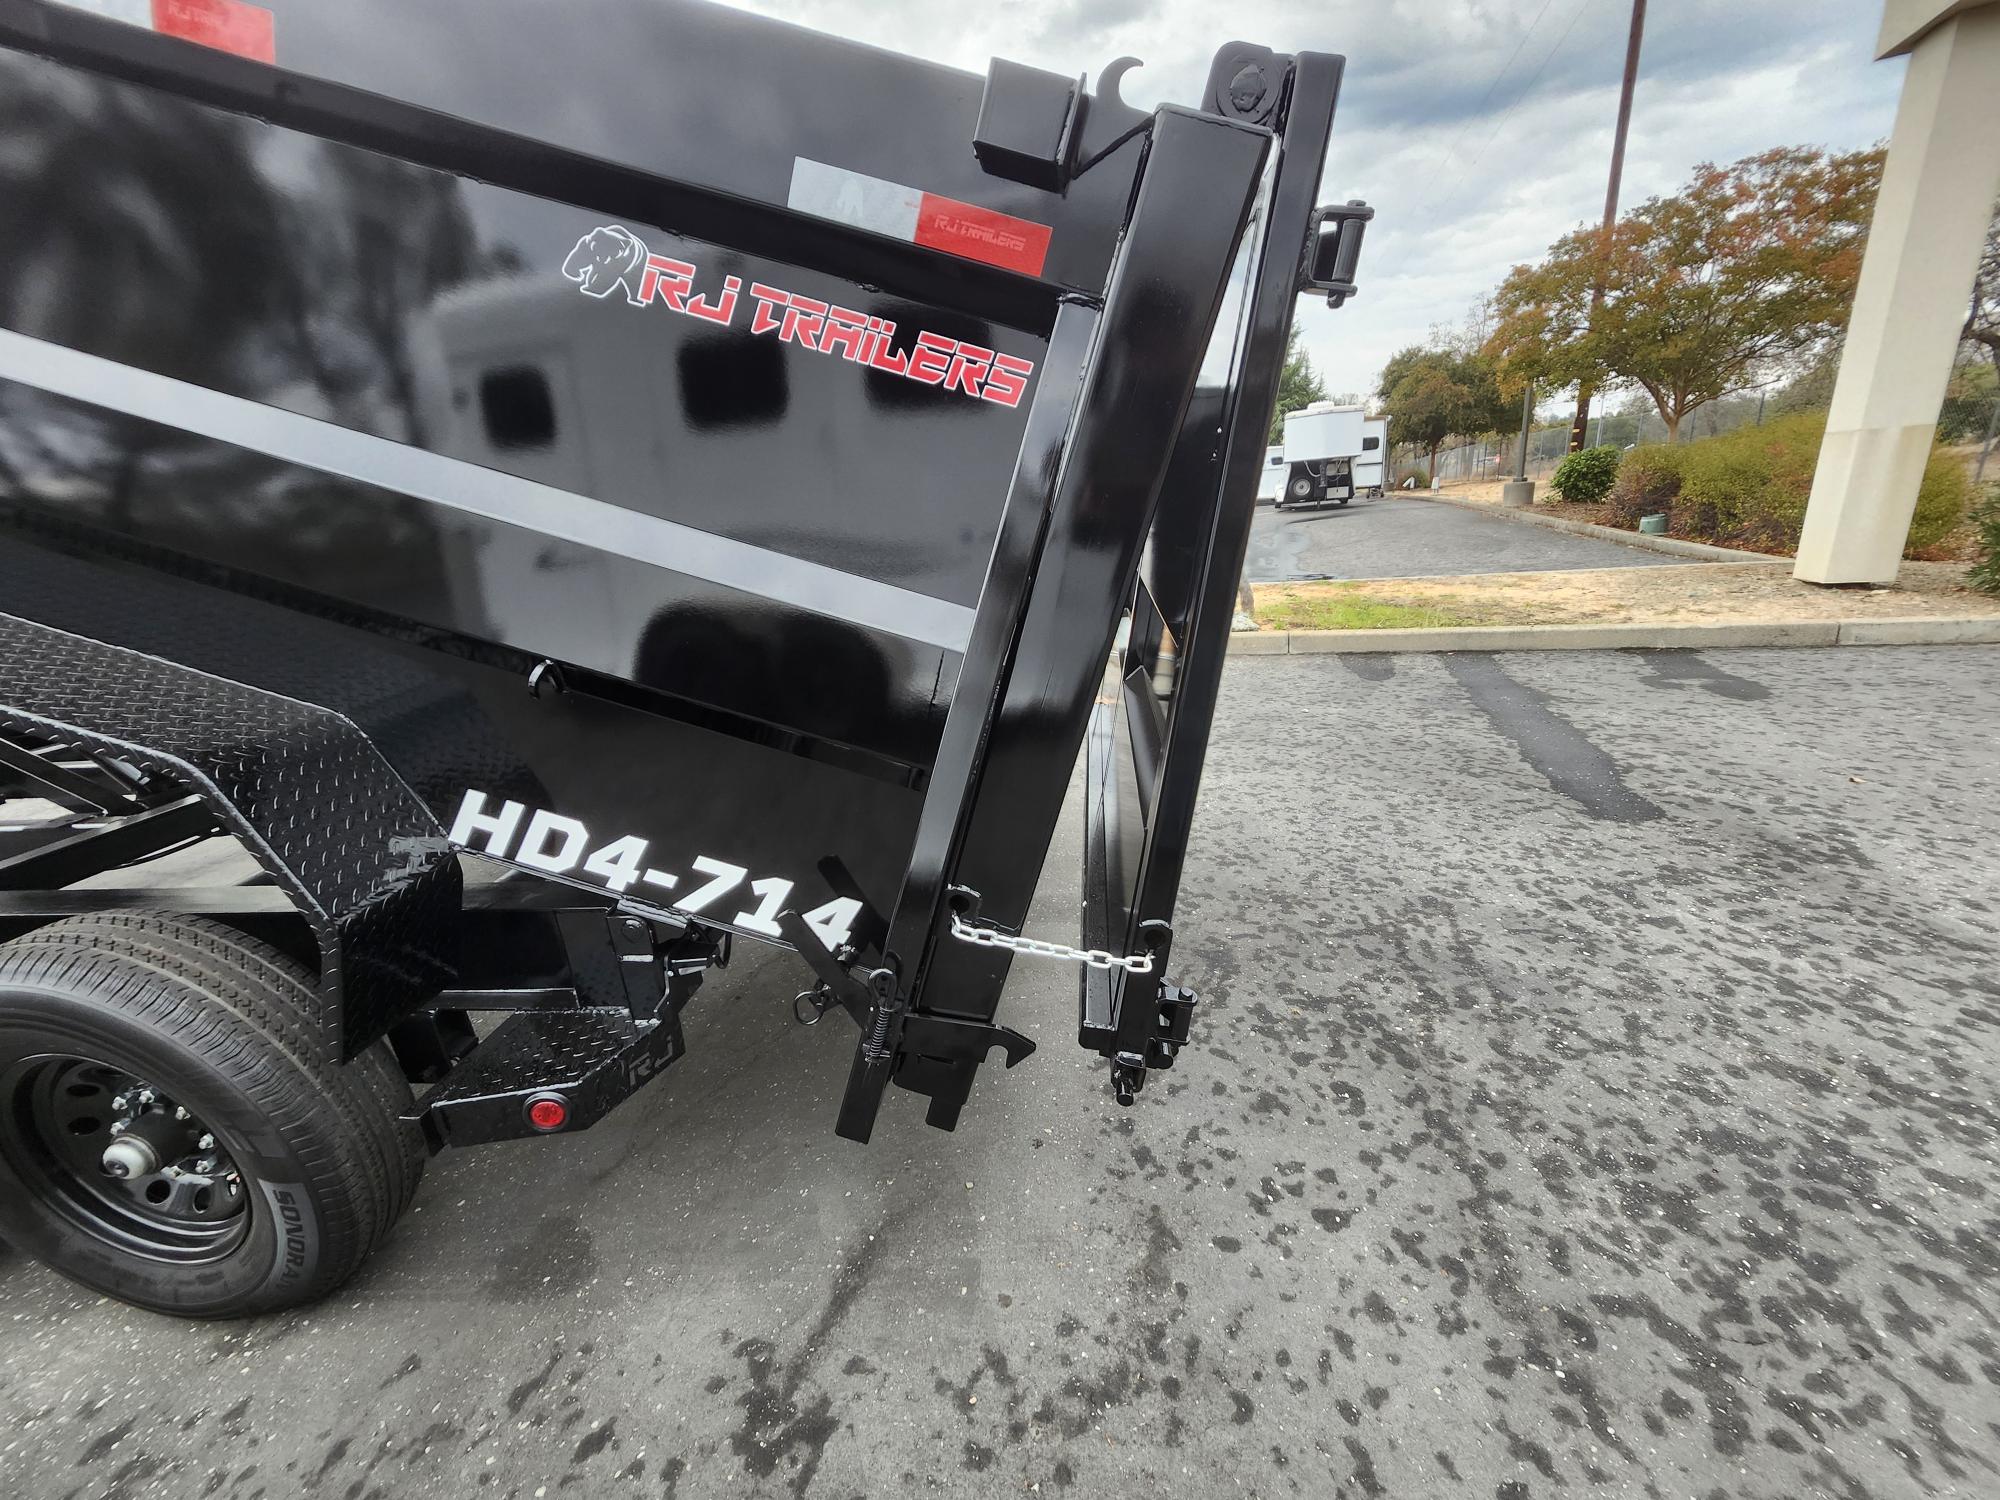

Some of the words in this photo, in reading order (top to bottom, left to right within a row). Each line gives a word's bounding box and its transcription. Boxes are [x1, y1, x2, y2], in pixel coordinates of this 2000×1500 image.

[934, 214, 960, 233] RJ
[960, 220, 1027, 251] TRAILERS
[638, 255, 743, 325] RJ
[750, 282, 1034, 408] TRAILERS
[448, 788, 864, 952] HD4-714
